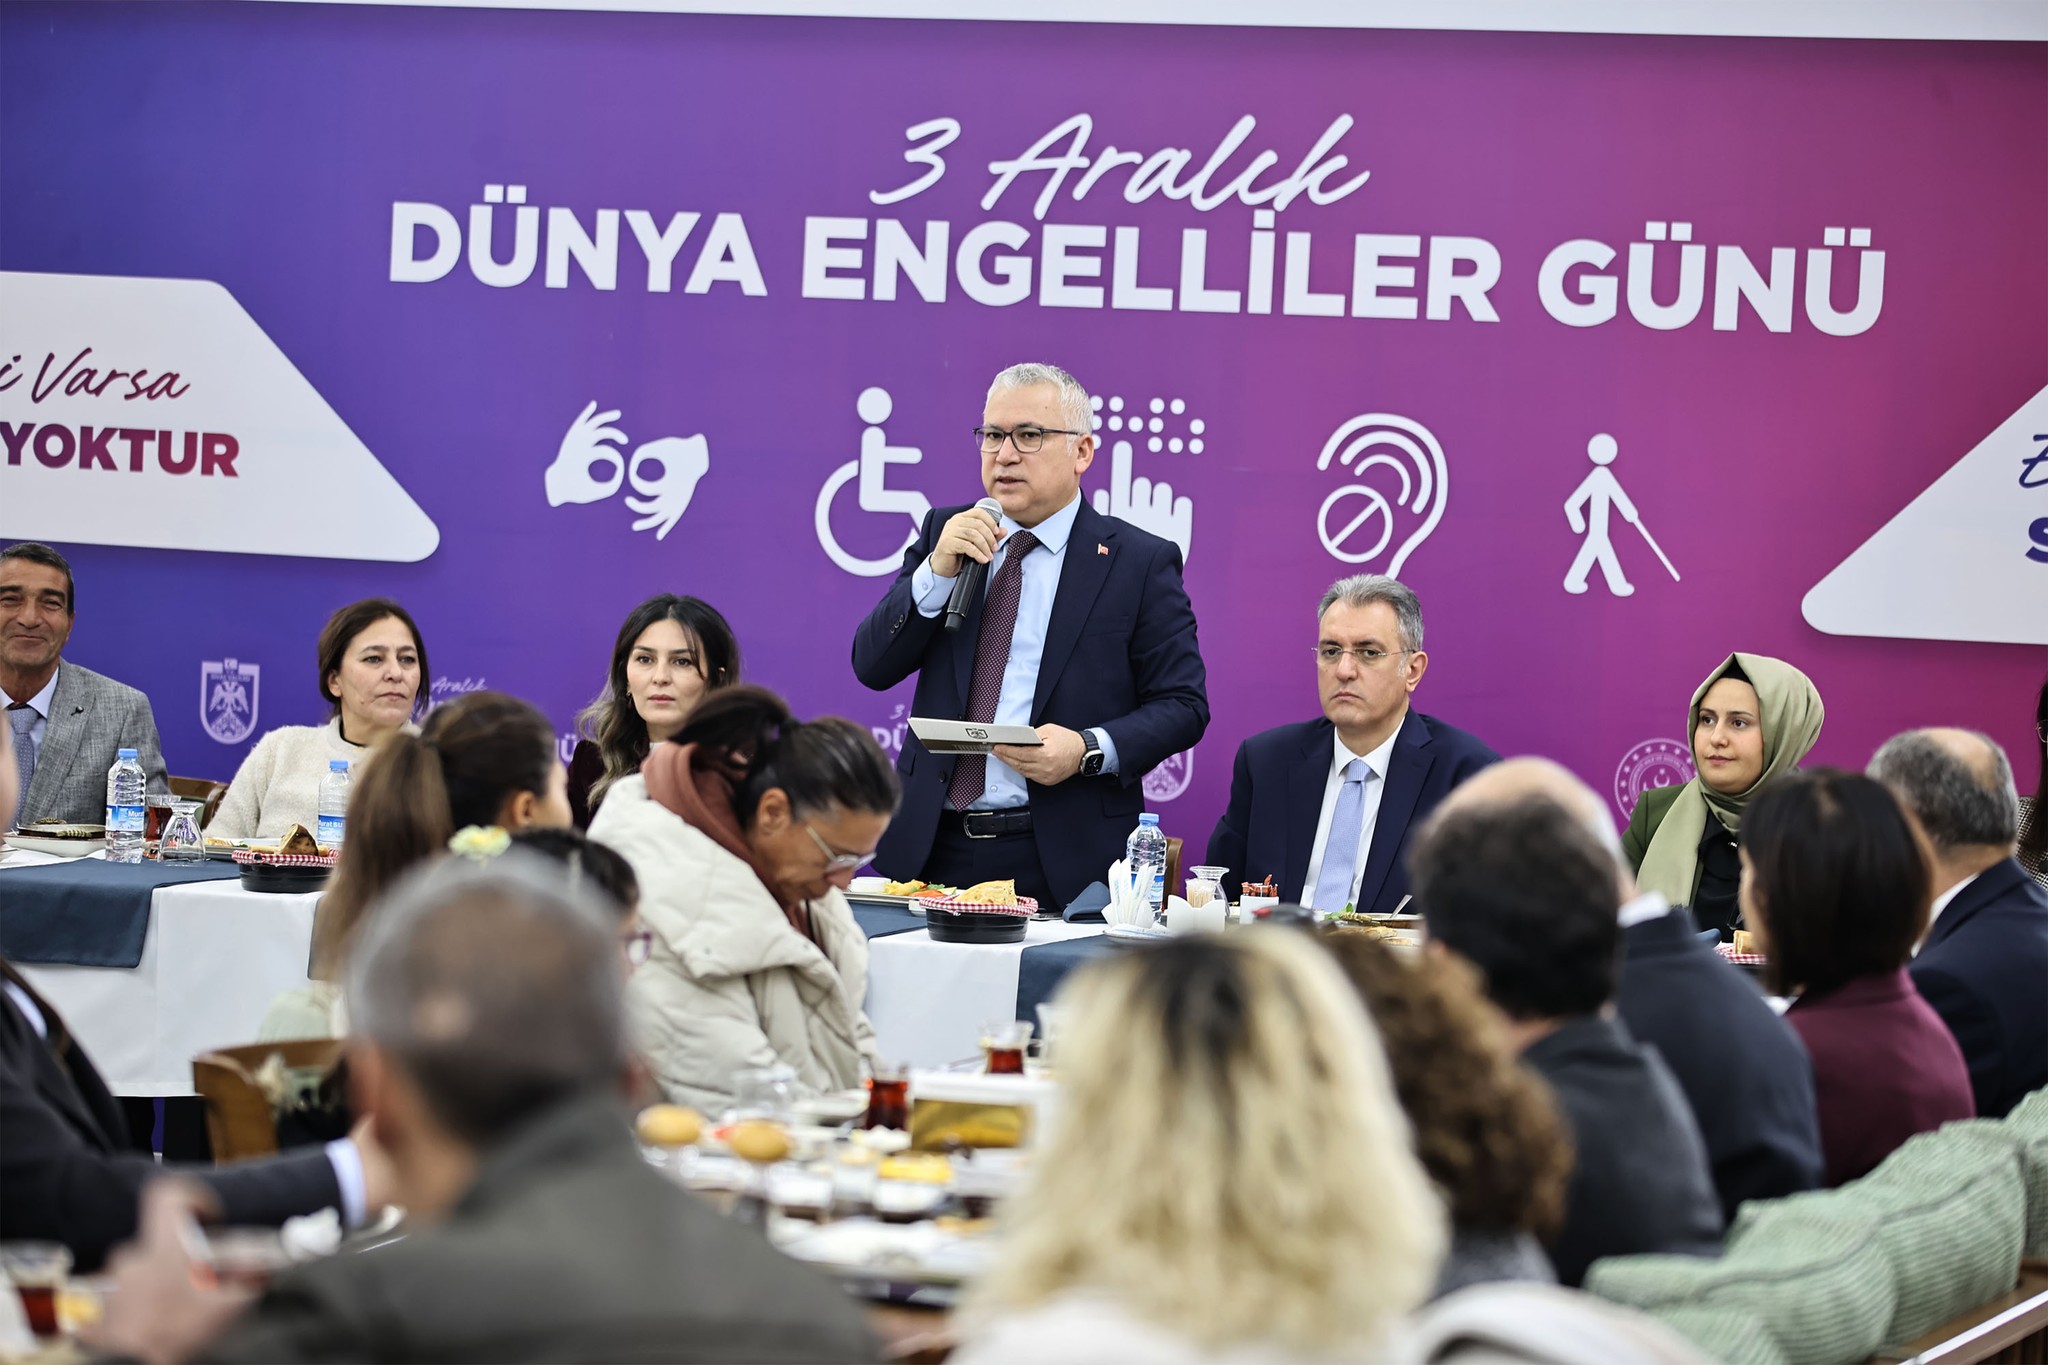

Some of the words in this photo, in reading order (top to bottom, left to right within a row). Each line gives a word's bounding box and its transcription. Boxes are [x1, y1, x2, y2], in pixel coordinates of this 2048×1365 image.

[868, 117, 962, 206] 3
[980, 113, 1371, 221] Aralık
[389, 184, 769, 297] DÜNYA
[801, 208, 1502, 323] ENGELLİLER
[1537, 220, 1887, 337] GÜNÜ
[30, 346, 191, 404] Varsa
[0, 420, 241, 479] YOKTUR
